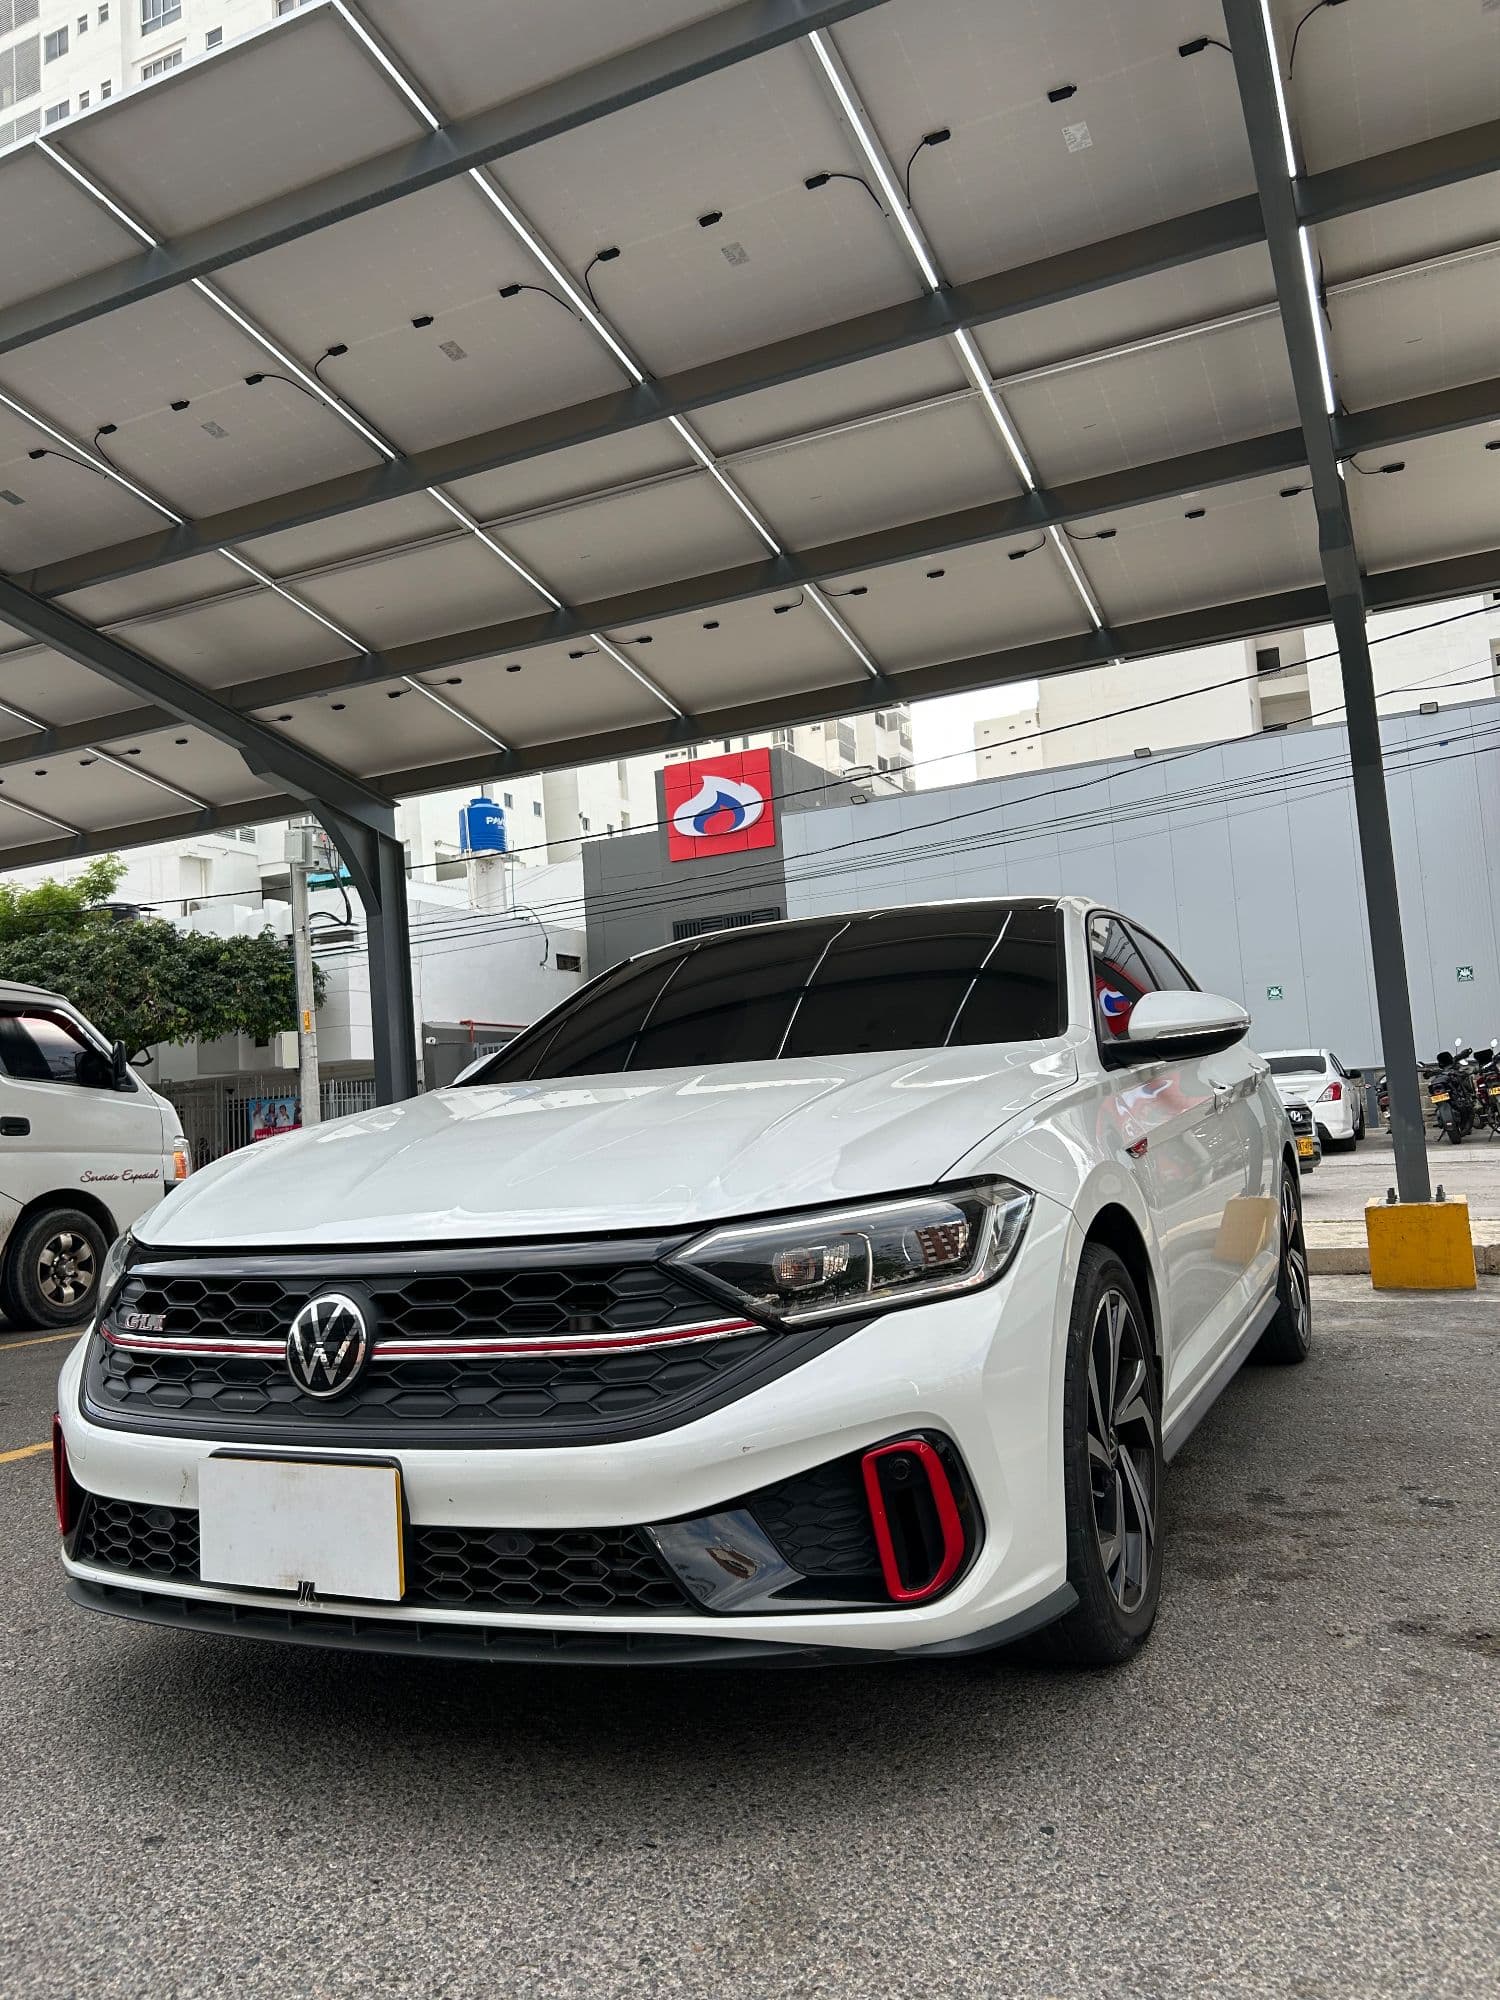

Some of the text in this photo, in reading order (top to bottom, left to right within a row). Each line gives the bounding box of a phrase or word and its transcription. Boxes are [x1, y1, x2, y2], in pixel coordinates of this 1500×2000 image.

[485, 816, 505, 826] PAV
[80, 1169, 159, 1183] Servicio Especial
[126, 1312, 166, 1331] GLI
